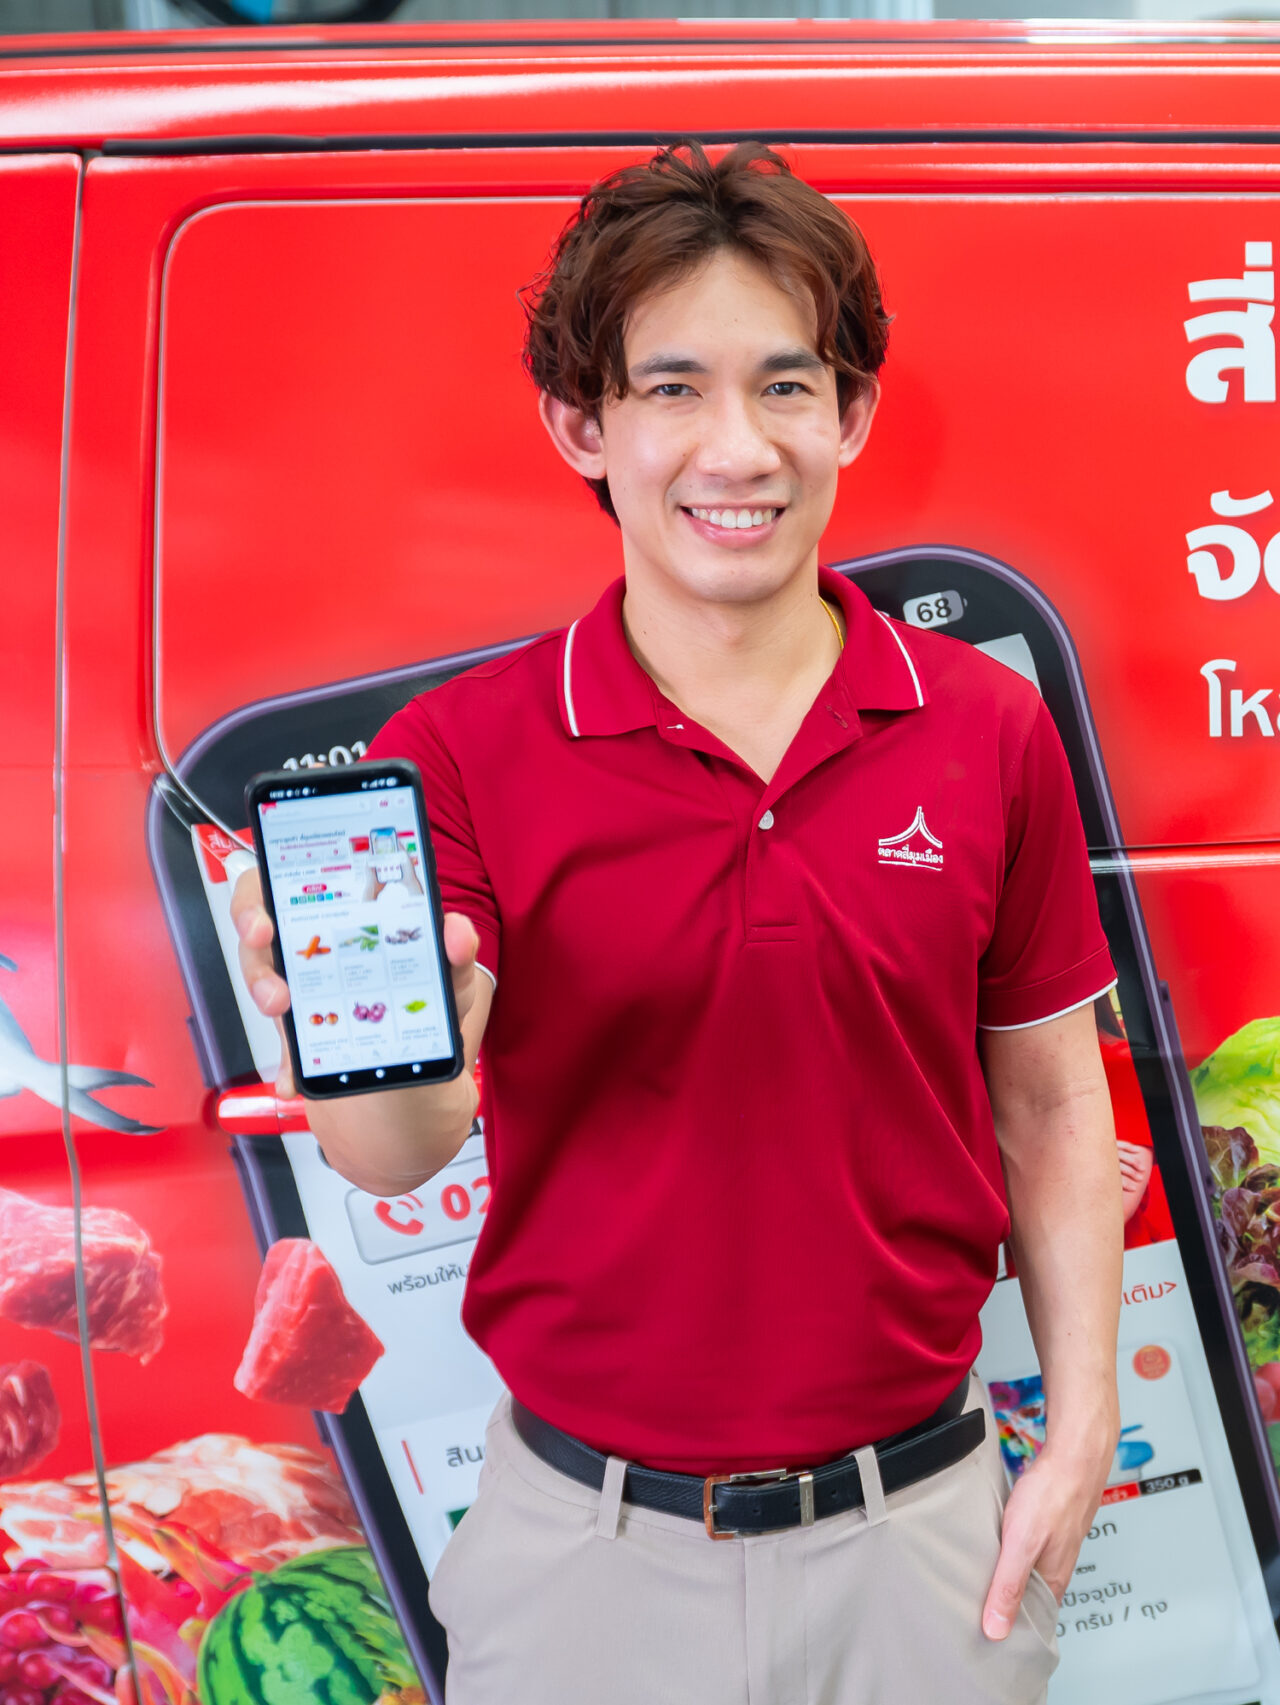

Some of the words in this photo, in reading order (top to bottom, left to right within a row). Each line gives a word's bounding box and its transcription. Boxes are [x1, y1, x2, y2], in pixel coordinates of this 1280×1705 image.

[916, 598, 952, 622] 68
[878, 844, 944, 865] ตลาดสี่มุมเมือง
[1145, 1476, 1175, 1493] 350
[1075, 1613, 1114, 1633] กรัม
